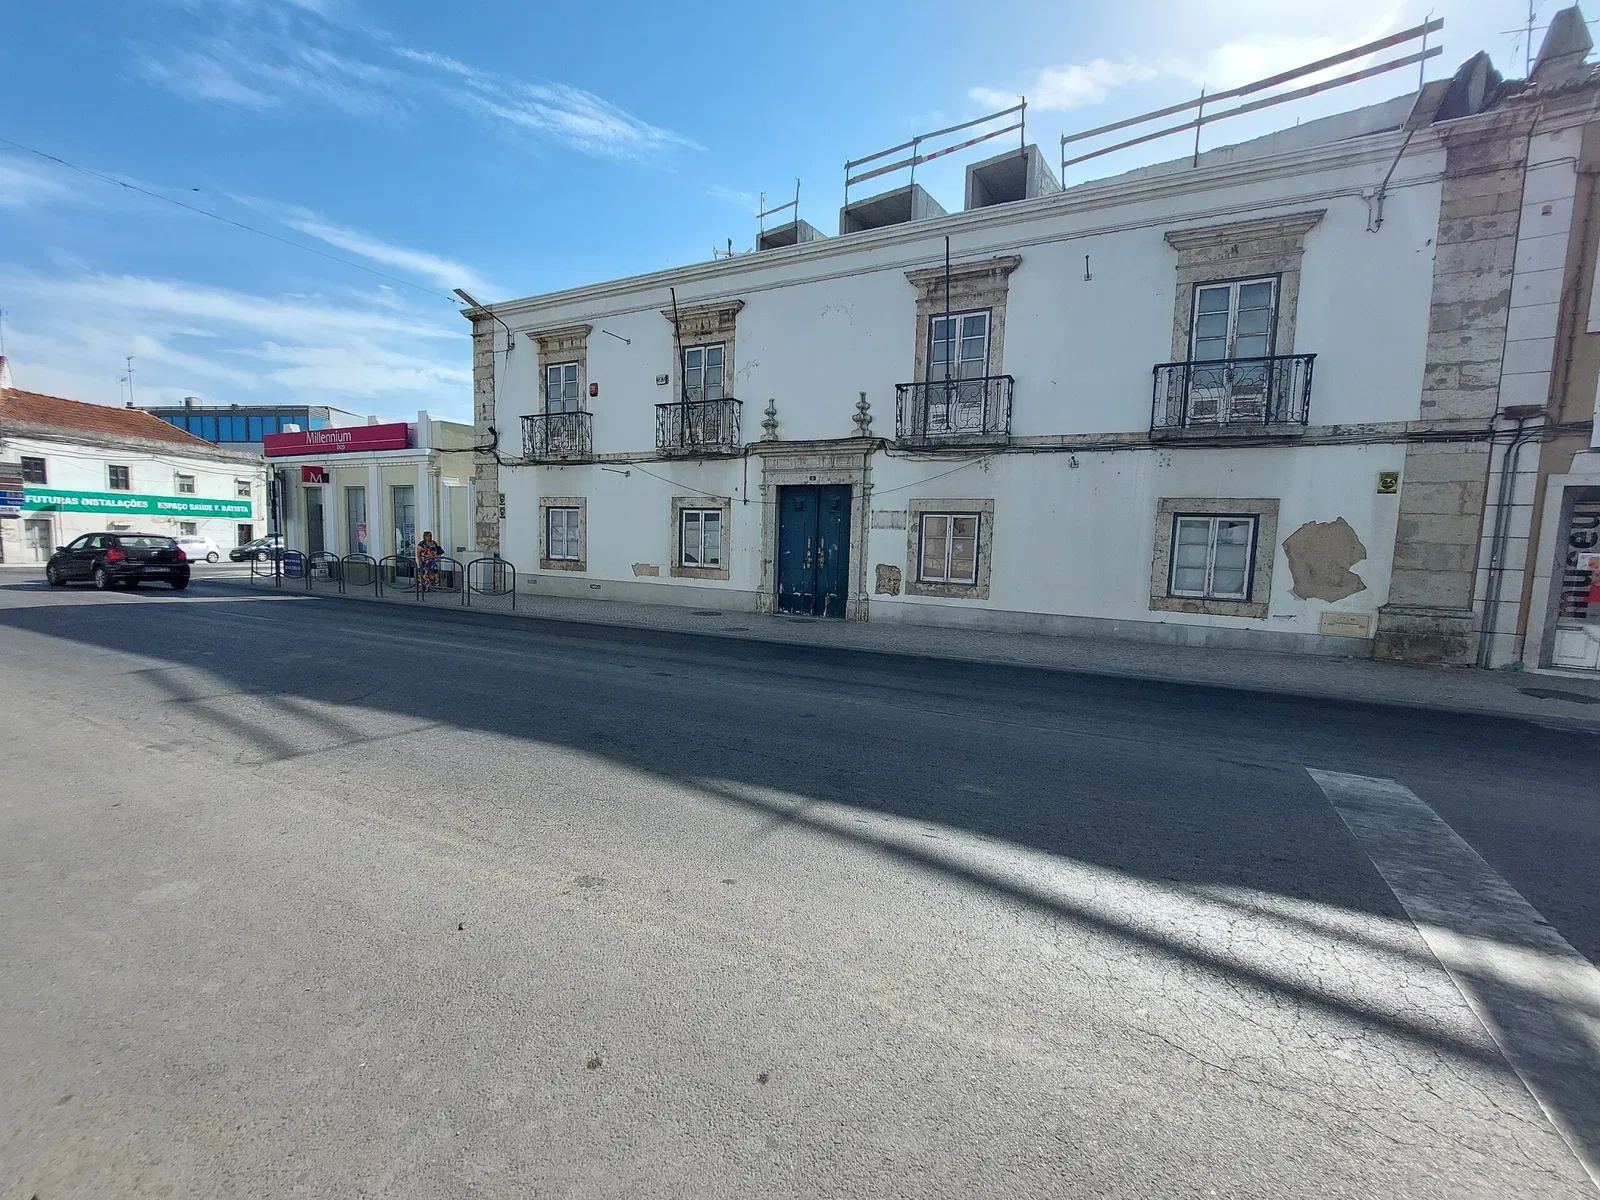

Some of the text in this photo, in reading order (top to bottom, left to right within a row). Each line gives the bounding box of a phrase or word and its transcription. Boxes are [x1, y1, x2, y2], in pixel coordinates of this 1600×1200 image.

[306, 430, 352, 444] Millennium
[310, 472, 322, 483] M
[25, 495, 79, 505] FUTURAS
[81, 497, 148, 508] INSTALAÇÕES
[157, 501, 188, 511] ESPAÇO
[189, 502, 213, 511] SAÚDE
